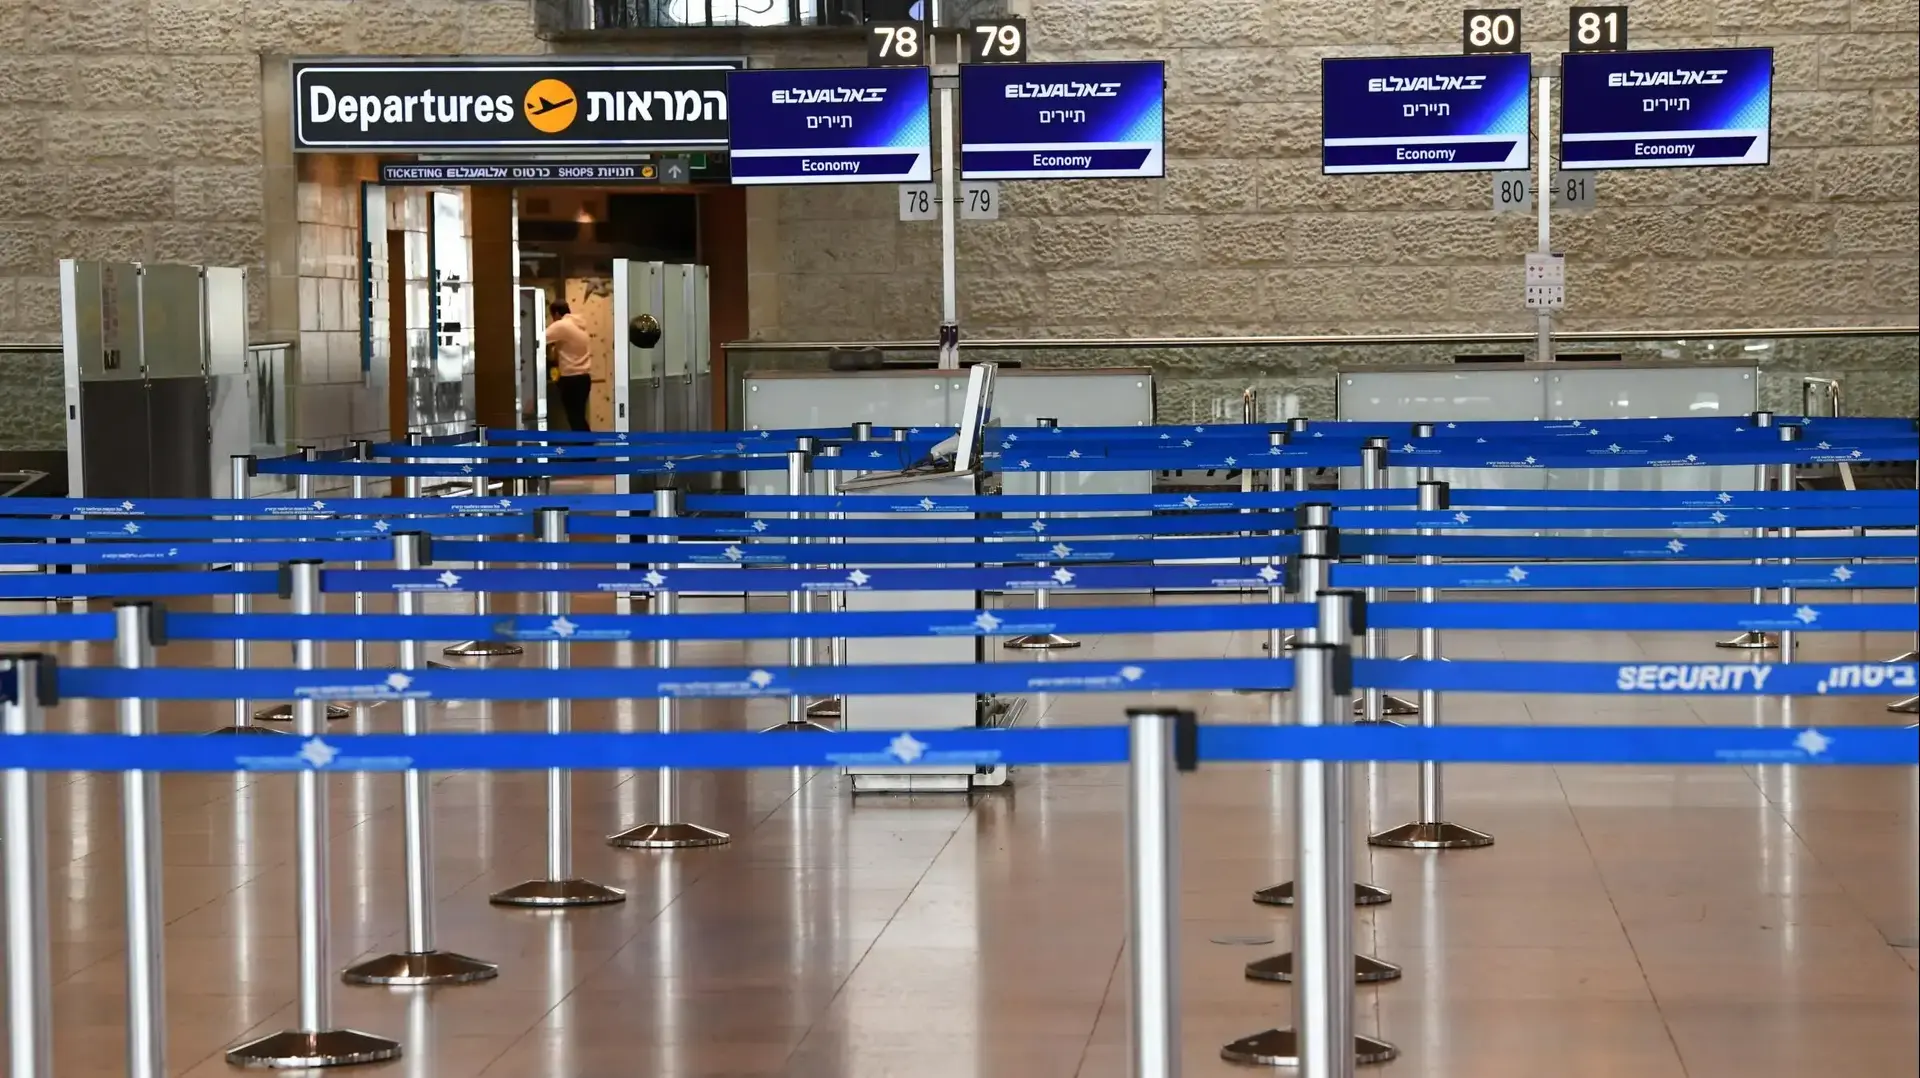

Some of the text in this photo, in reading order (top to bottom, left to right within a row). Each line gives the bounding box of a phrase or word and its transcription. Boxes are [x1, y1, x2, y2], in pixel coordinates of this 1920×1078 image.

[1469, 15, 1515, 46] 80
[1577, 13, 1617, 45] 81
[873, 27, 918, 58] 78
[975, 25, 1021, 57] 79
[310, 85, 727, 132] Departures המראות
[1403, 103, 1450, 117] תיירים
[1642, 97, 1690, 112] תיירים
[806, 115, 852, 129] תיירים
[1039, 110, 1086, 124] תיירים
[1396, 146, 1456, 162] Economy
[1634, 141, 1695, 157] Economy
[387, 168, 442, 178] TICKETING
[513, 168, 550, 178] כרטוס
[558, 167, 594, 177] SHOPS
[598, 167, 634, 177] חנויות
[801, 158, 861, 174] Economy
[1033, 153, 1092, 169] Economy
[969, 189, 990, 212] 79
[1501, 180, 1524, 203] 80
[1566, 178, 1585, 201] 81
[907, 190, 929, 213] 78
[1617, 665, 1772, 691] SECURITY
